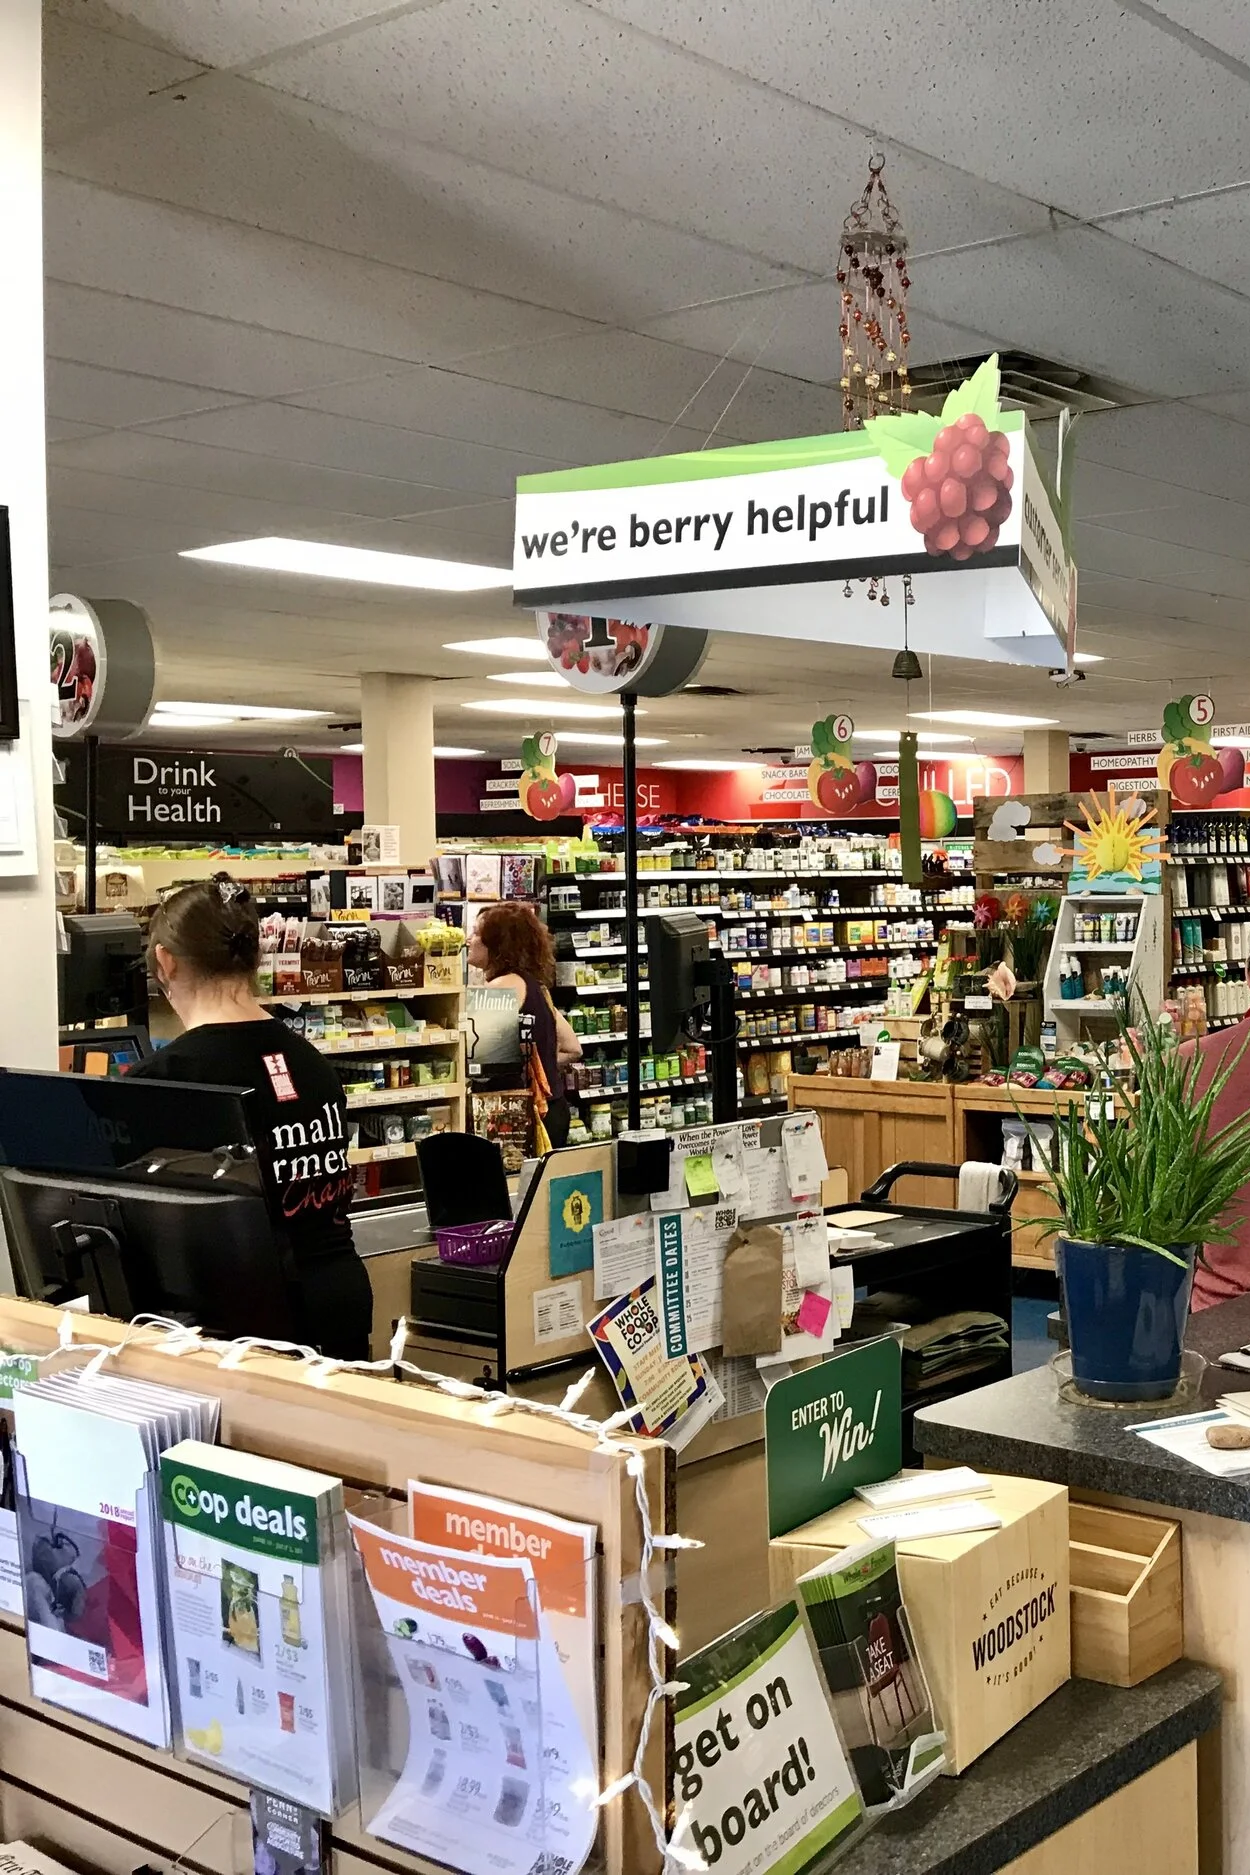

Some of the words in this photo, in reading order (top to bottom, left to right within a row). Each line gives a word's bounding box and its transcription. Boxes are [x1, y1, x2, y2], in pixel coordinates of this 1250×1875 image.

[522, 519, 617, 558] we're
[629, 508, 733, 550] berry
[747, 485, 889, 541] helpful
[51, 631, 79, 701] 2
[1197, 699, 1208, 722] 5
[837, 718, 848, 739] 6
[1129, 732, 1157, 743] HERBS
[1213, 726, 1237, 737] FIRST
[543, 736, 552, 753] 7
[796, 747, 811, 756] JAM
[133, 757, 217, 788] Drink
[503, 760, 521, 770] SODA
[761, 769, 787, 779] SNACK
[788, 768, 808, 778] BARS
[1092, 757, 1155, 768] HOMEOPATHY
[158, 787, 168, 795] to
[170, 788, 192, 797] your
[488, 780, 520, 791] CRACKERS
[764, 790, 810, 800] CHOCOLATE
[128, 795, 221, 823] Health
[470, 989, 517, 1011] Atlantic
[679, 1130, 700, 1143] When
[700, 1129, 712, 1140] the
[742, 1124, 756, 1134] Love
[677, 1138, 710, 1151] Overcomes
[689, 1145, 710, 1157] World
[715, 1208, 736, 1217] WHOLE
[715, 1214, 736, 1223] FOODS
[664, 1220, 678, 1266] DATES
[614, 1295, 650, 1330] WHOLE
[621, 1305, 655, 1341] FOODS
[666, 1270, 683, 1354] COMMITTEE
[627, 1315, 660, 1351] CO-OP
[791, 1396, 828, 1431] ENTER
[829, 1390, 845, 1414] TO
[819, 1389, 882, 1482] Win!
[99, 1502, 120, 1518] 2018
[235, 1494, 308, 1541] deals
[445, 1511, 552, 1560] member
[380, 1546, 488, 1592] member
[411, 1577, 478, 1614] deals
[989, 1586, 1003, 1608] EAT
[1006, 1567, 1039, 1591] BECAUSE
[972, 1583, 1057, 1672] WOODSTOCK
[865, 1636, 887, 1665] TAKE
[875, 1652, 895, 1681] SEAT
[993, 1670, 1010, 1687] IT'S
[1014, 1645, 1037, 1678] GOOD!
[675, 1707, 740, 1802] get
[746, 1675, 793, 1730] on
[691, 1736, 816, 1865] board!
[779, 1821, 801, 1846] board
[810, 1786, 840, 1818] directors
